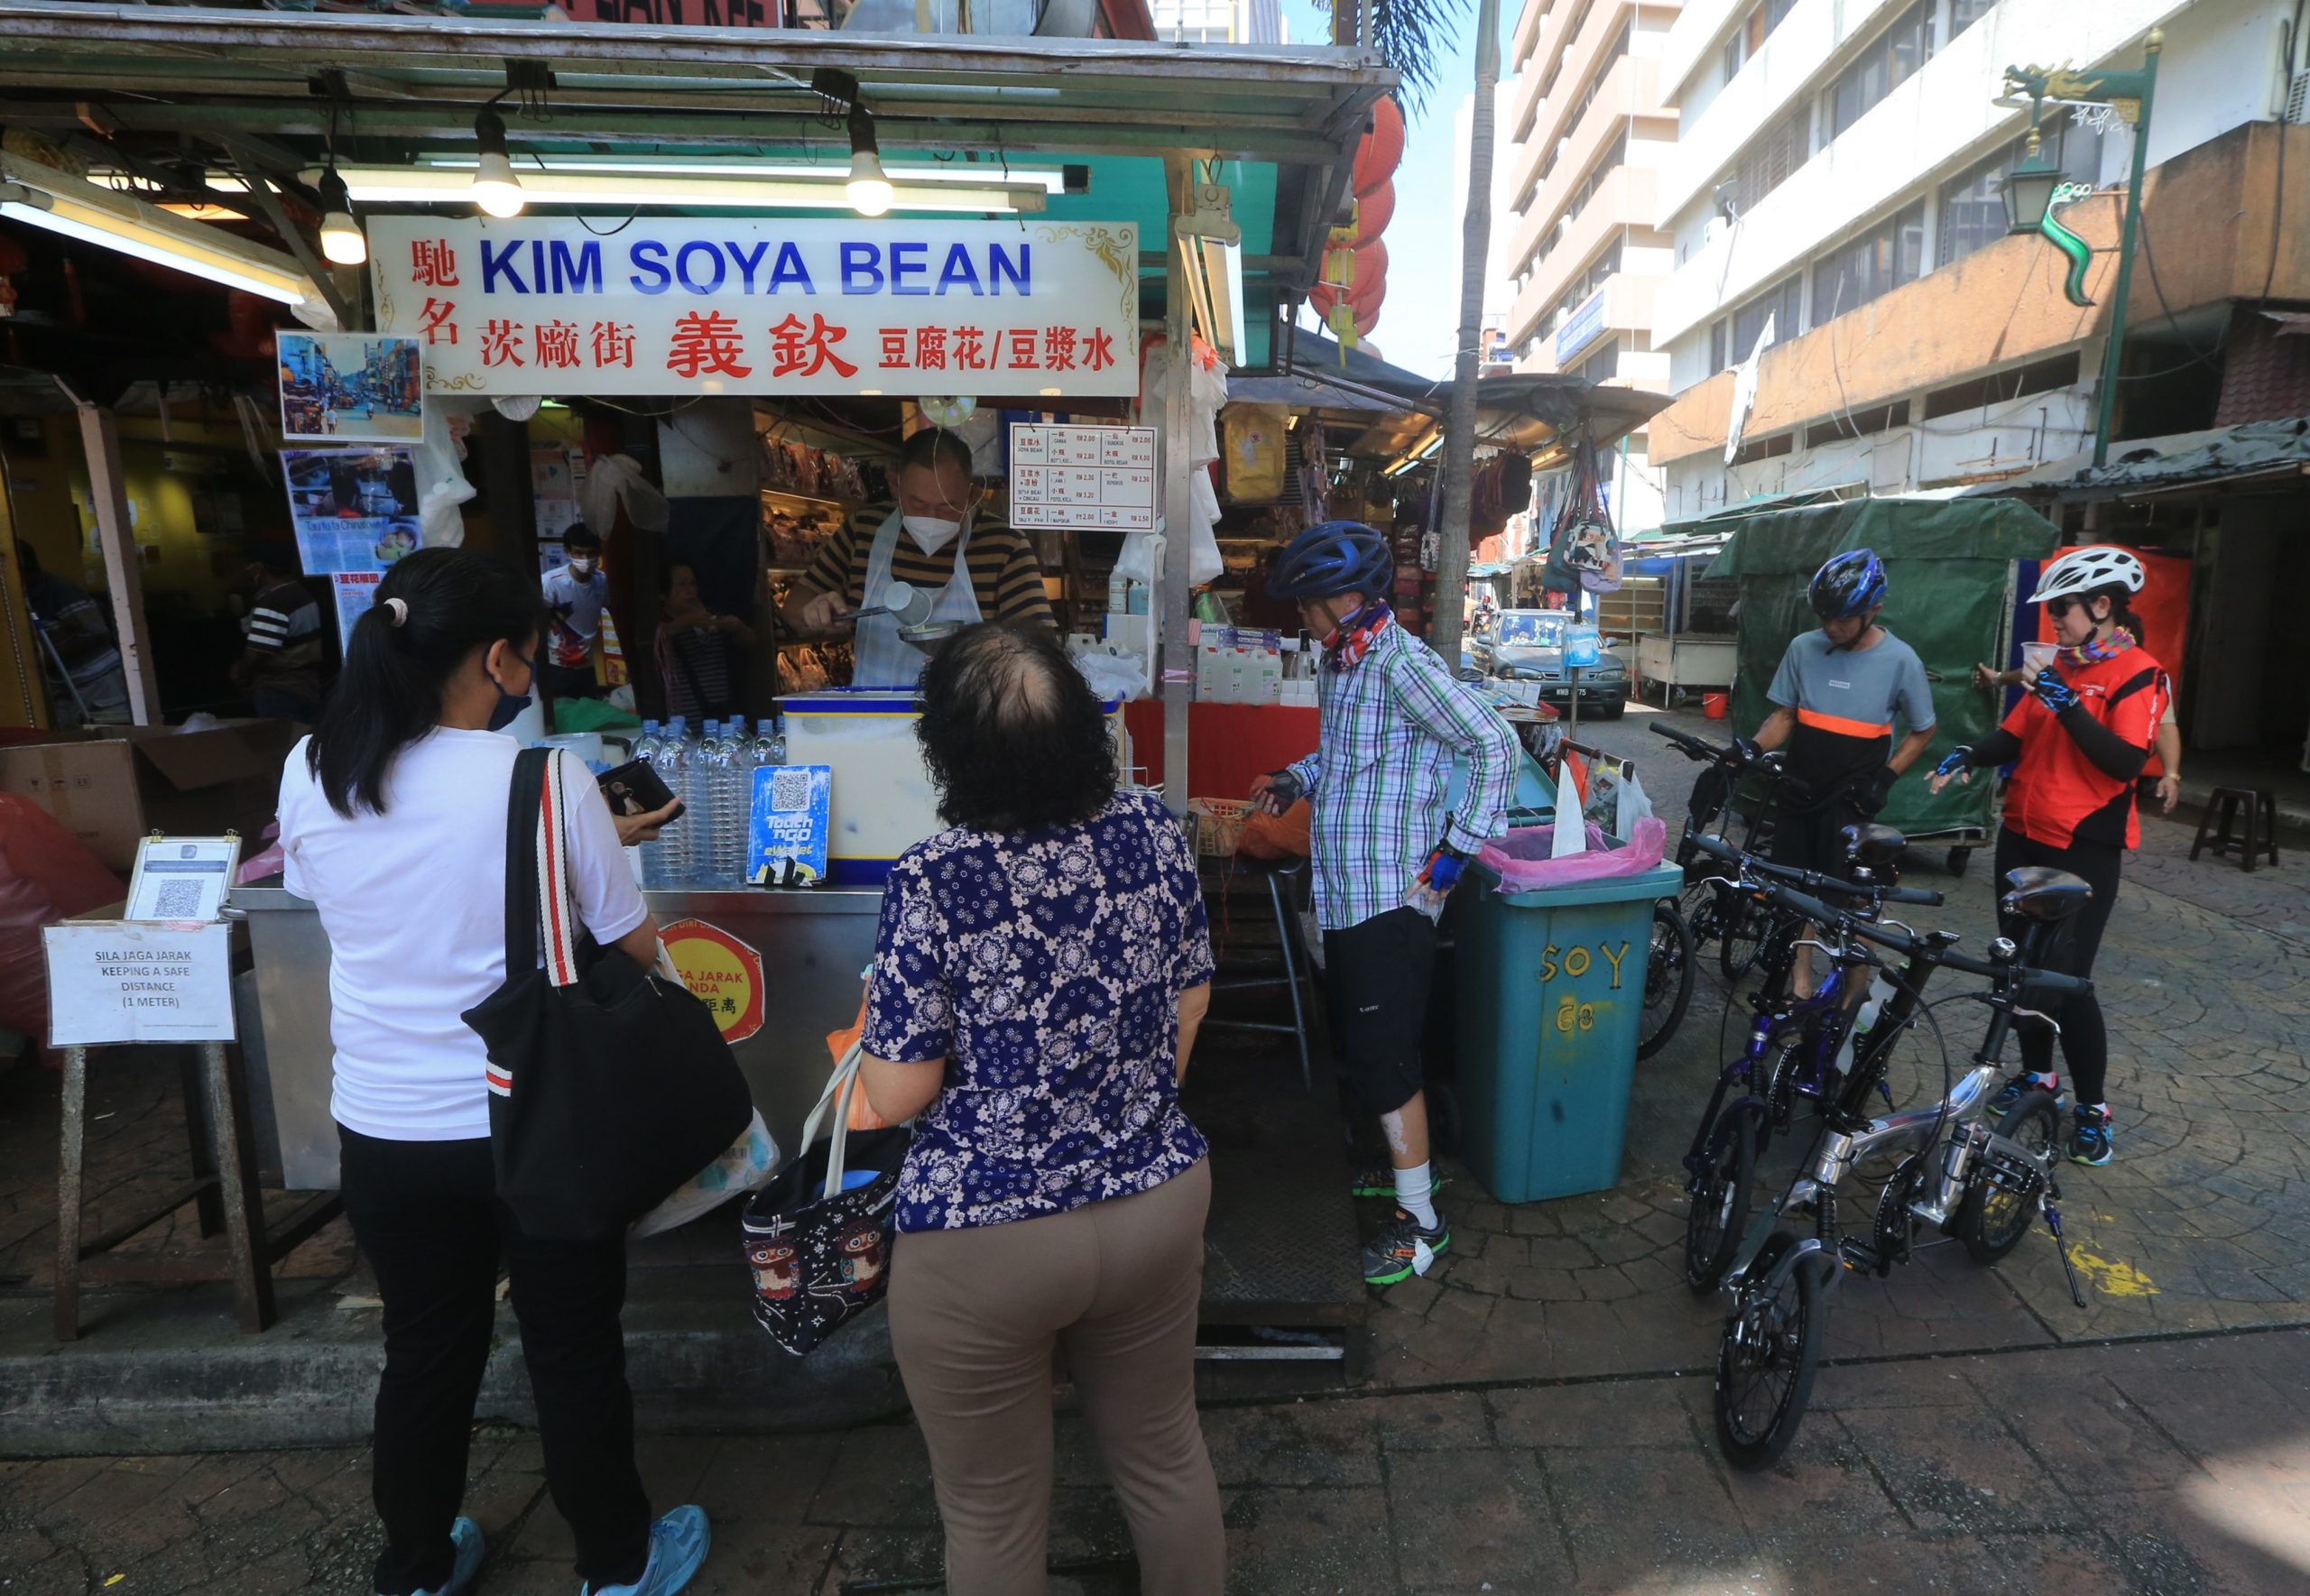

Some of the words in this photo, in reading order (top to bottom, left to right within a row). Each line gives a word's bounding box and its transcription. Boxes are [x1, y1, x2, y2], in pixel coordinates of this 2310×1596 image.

[480, 240, 604, 294] KIM
[629, 240, 817, 295] SOYA
[839, 242, 1031, 296] BEAN
[411, 239, 459, 346] 馳名
[476, 319, 637, 368] 茨廠街
[667, 310, 858, 379] 義欽
[878, 326, 1115, 372] 豆腐花/豆漿水
[95, 951, 120, 961] SILA
[124, 951, 153, 961] JAGA
[156, 951, 192, 961] JARAK
[101, 966, 150, 976] KEEPING
[152, 966, 162, 976] A
[163, 966, 190, 976] SAFE
[1538, 940, 1631, 990] SOY
[698, 972, 743, 983] JARAK
[121, 983, 176, 992] DISTANCE
[123, 997, 134, 1009] (1
[137, 997, 180, 1009] METER)
